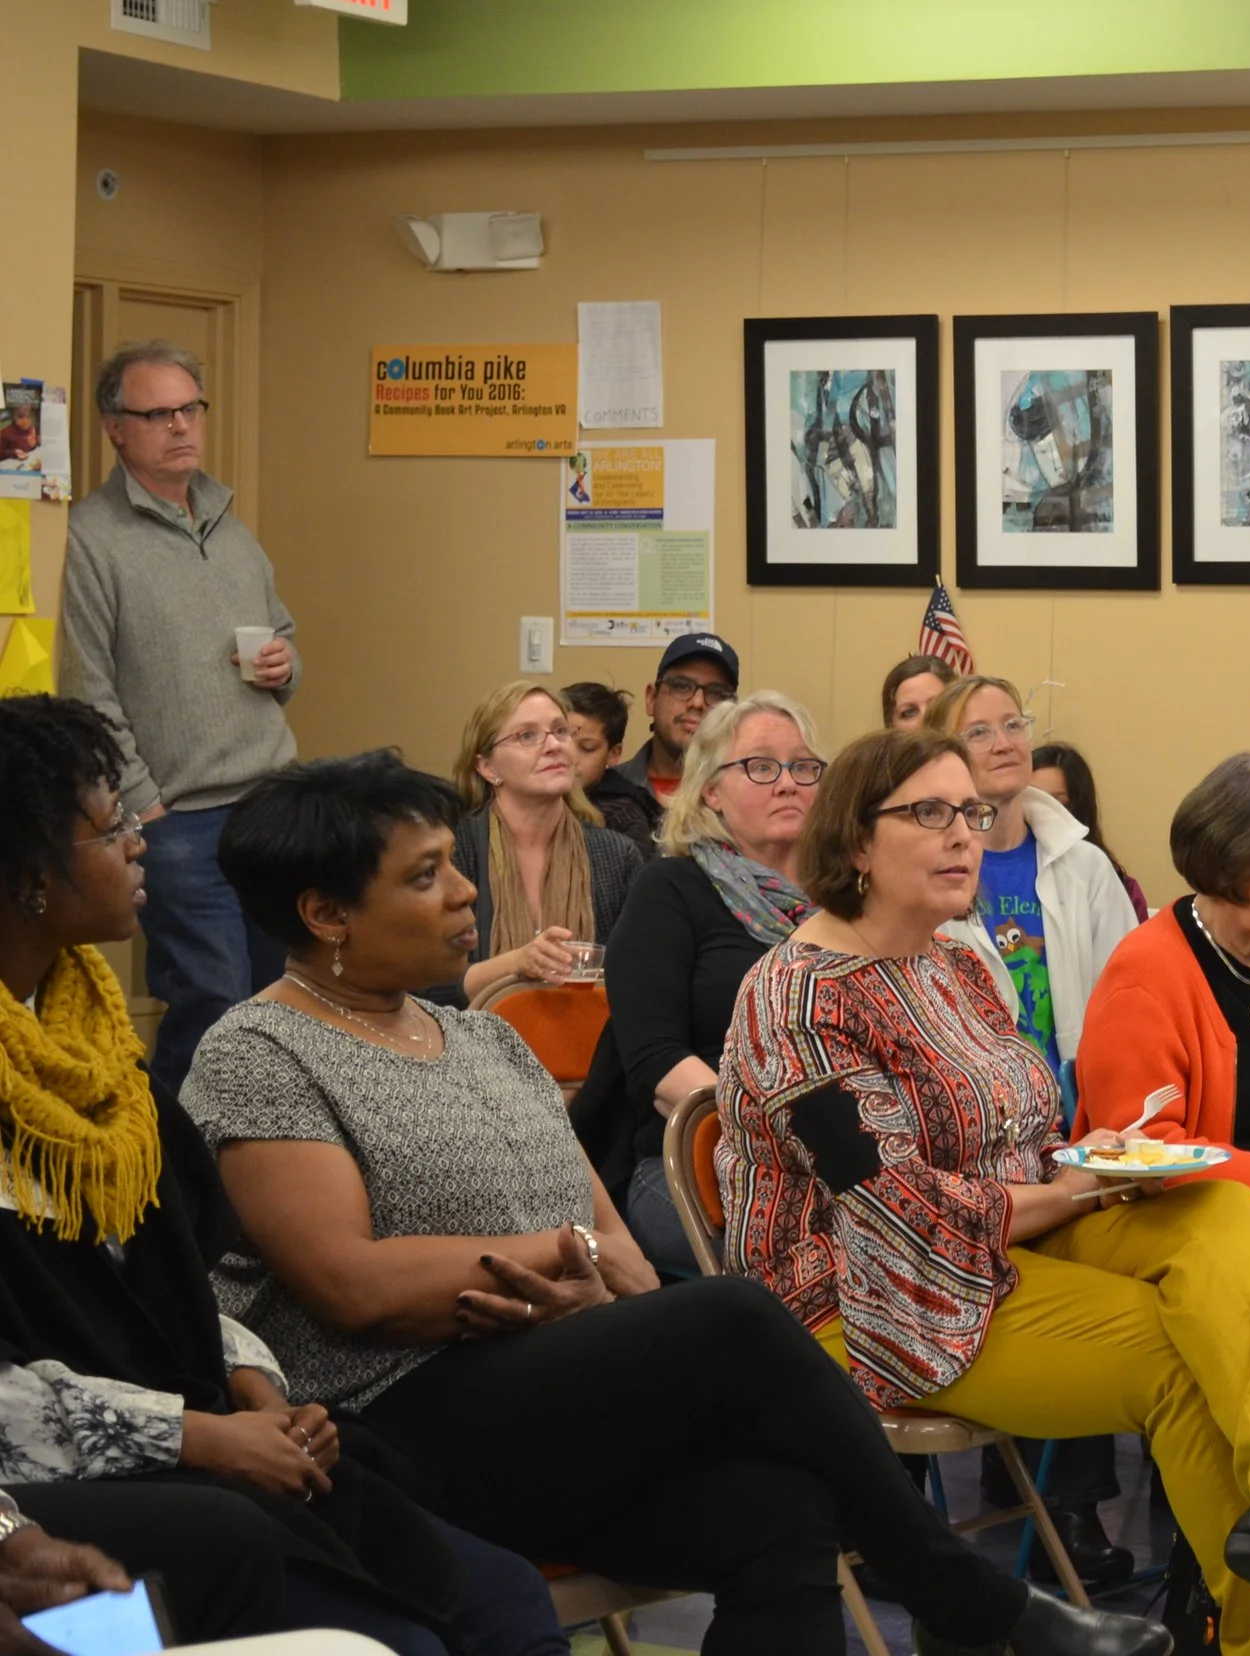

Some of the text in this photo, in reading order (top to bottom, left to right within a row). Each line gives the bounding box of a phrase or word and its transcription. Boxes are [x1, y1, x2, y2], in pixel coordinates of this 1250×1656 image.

[376, 355, 526, 384] columbia pike
[375, 384, 526, 402] Recipes for You 2016:
[383, 404, 433, 417] Community
[435, 404, 456, 415] Book
[458, 404, 473, 415] Art
[475, 404, 510, 417] Project,
[512, 404, 553, 418] Arlington
[584, 407, 659, 424] COMMENTS
[505, 439, 573, 452] arlington arts
[593, 448, 662, 460] WE ARE ALL
